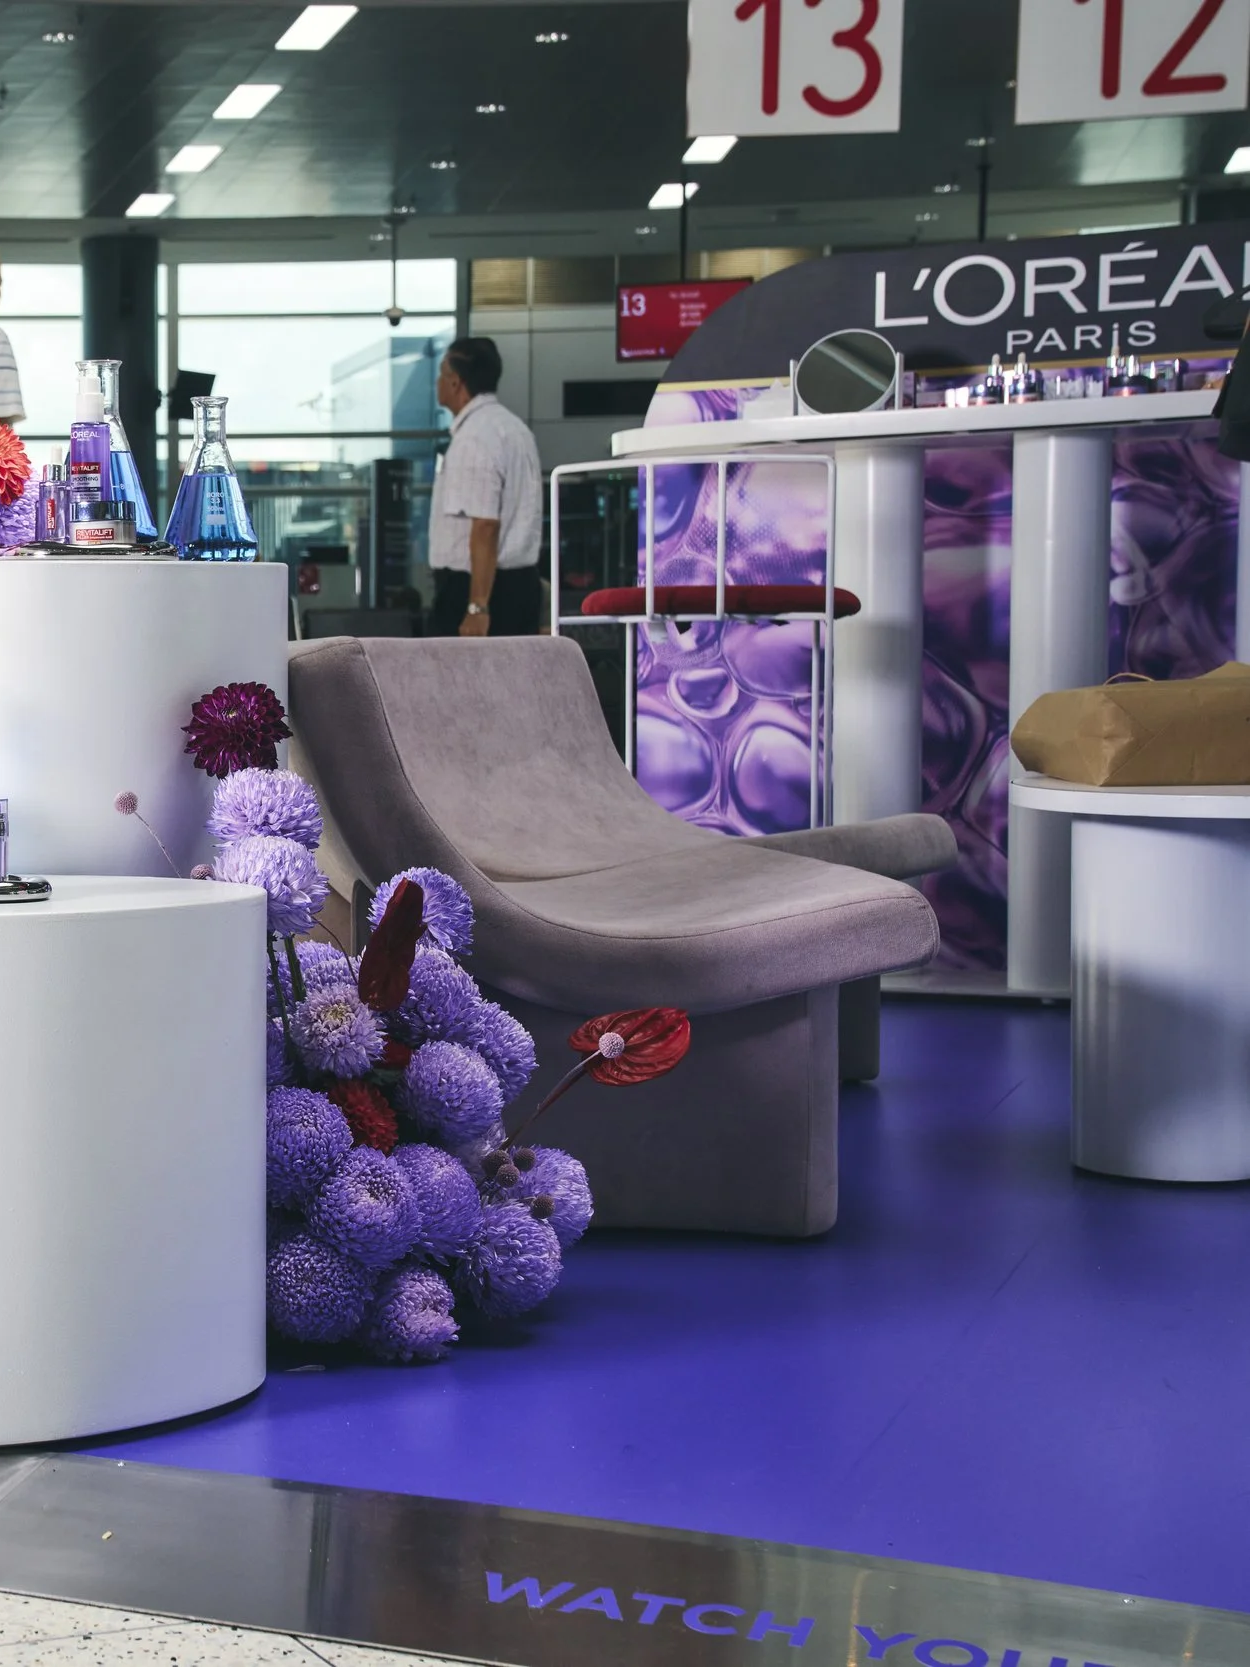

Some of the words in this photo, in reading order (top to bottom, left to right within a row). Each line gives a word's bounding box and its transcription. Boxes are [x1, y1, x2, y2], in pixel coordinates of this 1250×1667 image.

[735, 0, 882, 118] 13
[1073, 0, 1227, 99] 12
[620, 292, 646, 317] 13
[875, 241, 1250, 328] L'ORÉA
[1006, 321, 1157, 355] PARIS
[486, 1571, 816, 1648] WATCH
[853, 1625, 1120, 1667] YO
